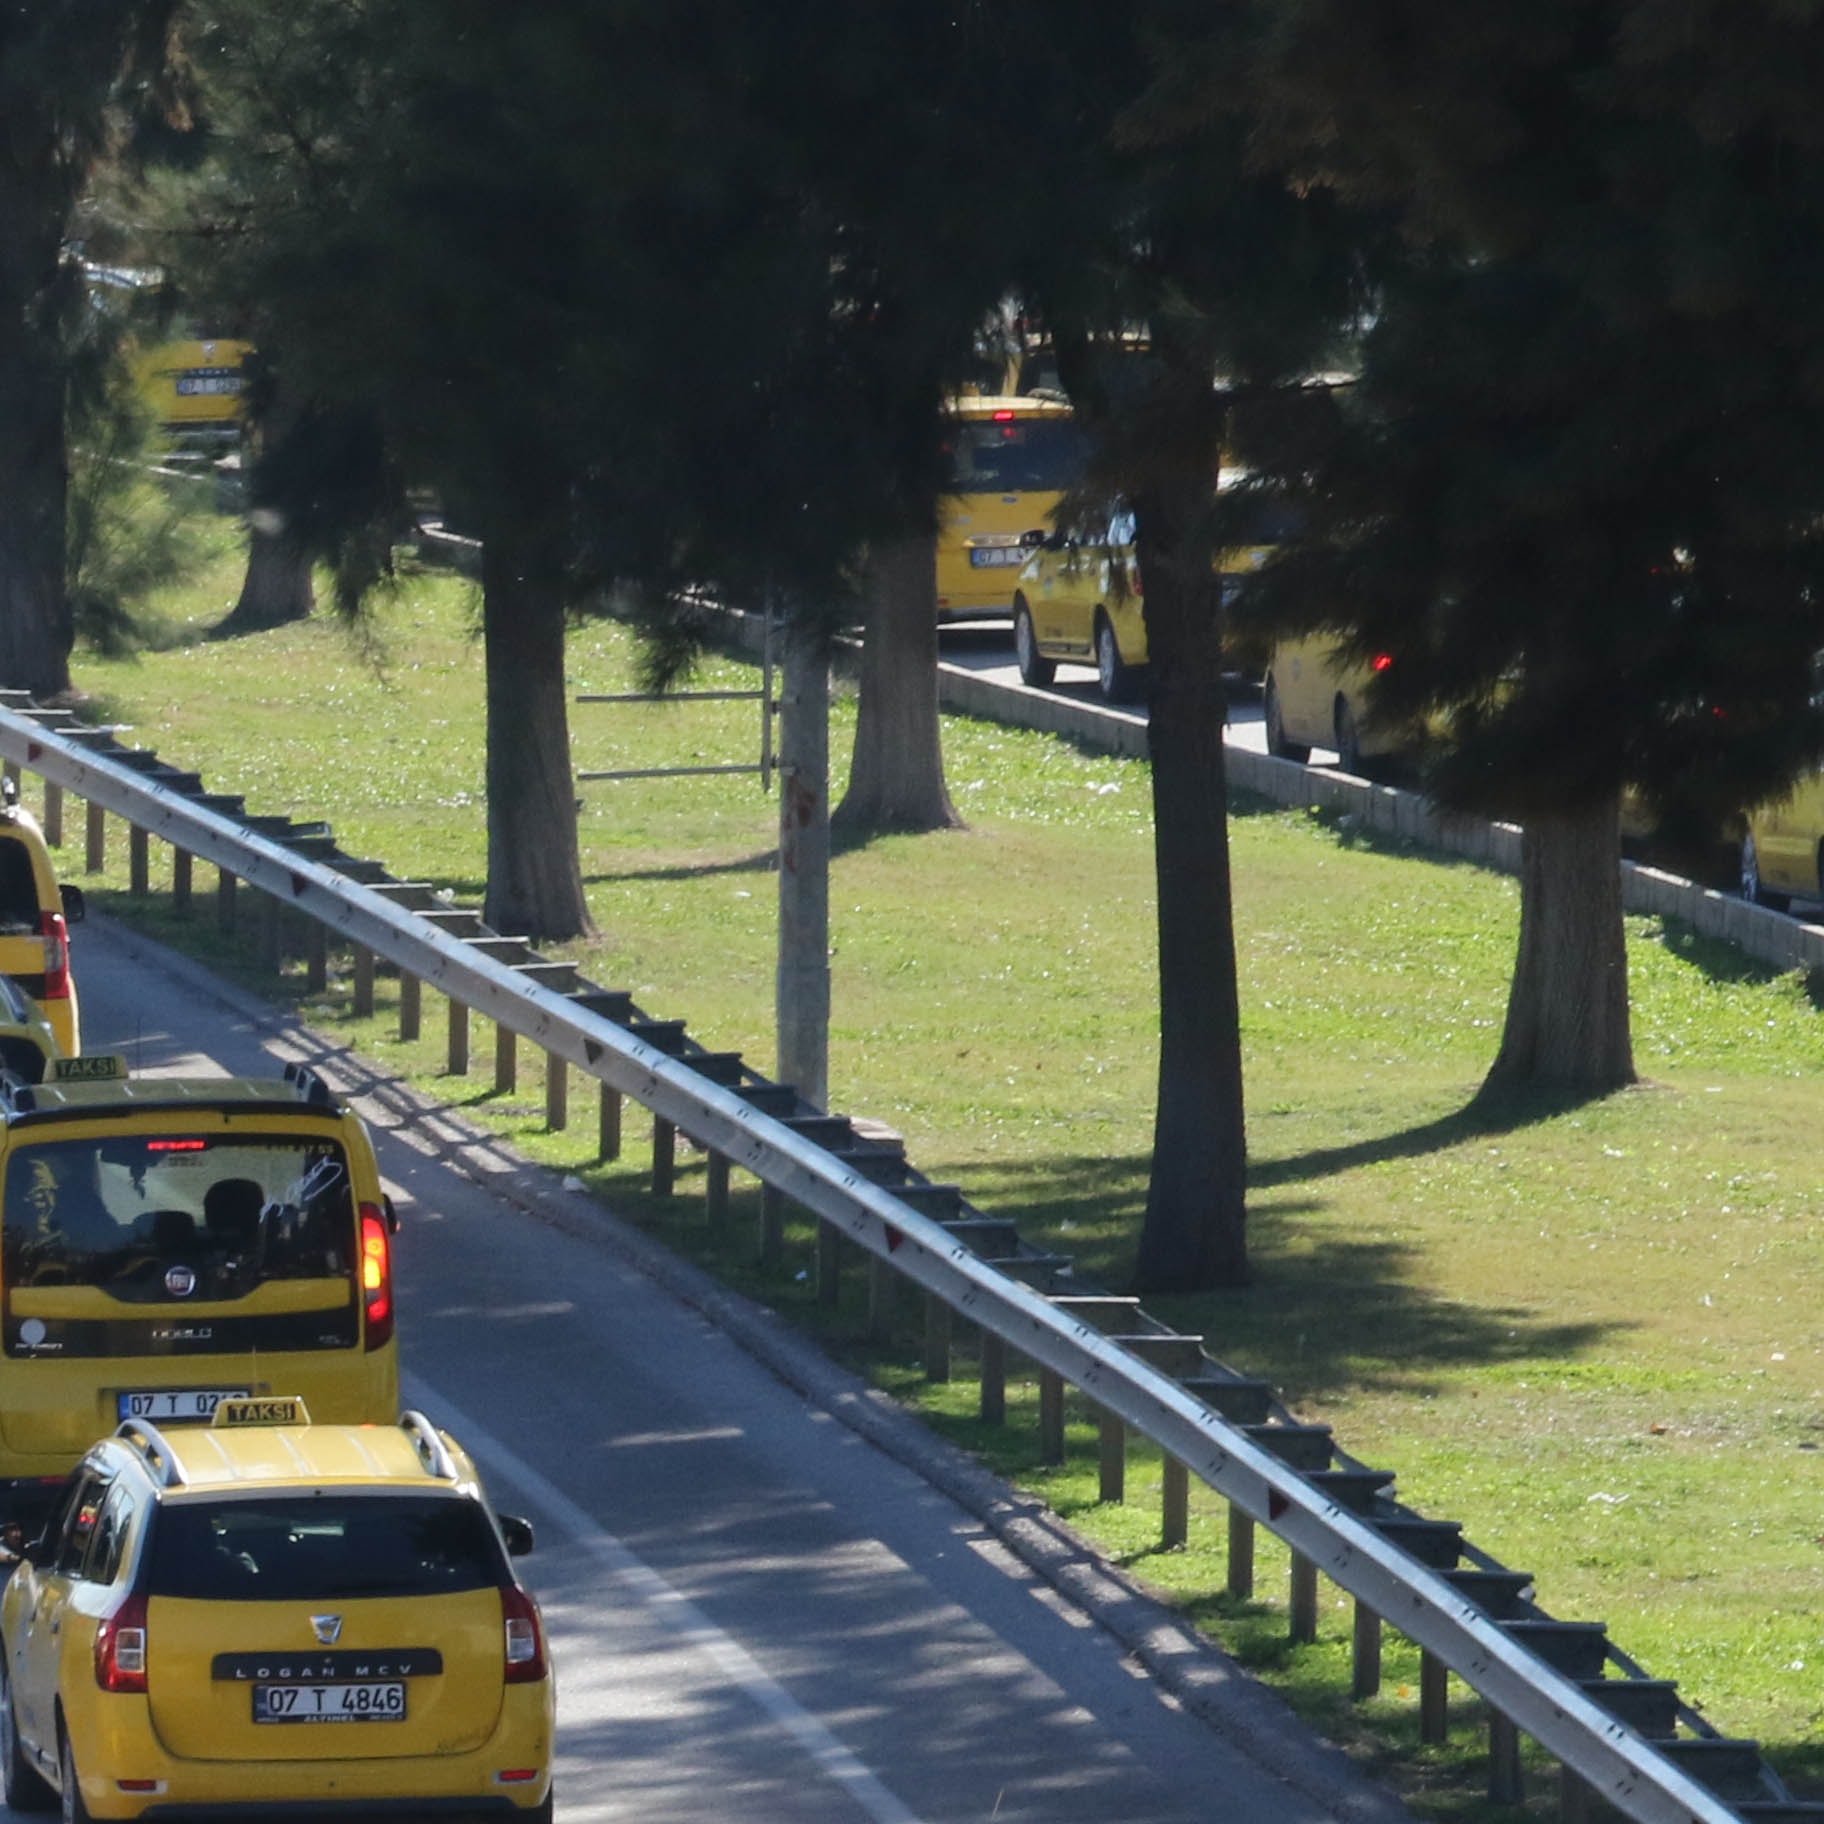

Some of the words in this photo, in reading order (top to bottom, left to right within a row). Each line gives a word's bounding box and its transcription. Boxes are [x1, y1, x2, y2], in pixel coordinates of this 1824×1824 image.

[131, 1395, 154, 1415] 07
[167, 1395, 179, 1413] T
[236, 1667, 334, 1678] LOGAN
[355, 1665, 412, 1677] MCV
[269, 1690, 298, 1713] 07
[312, 1690, 326, 1711] T
[342, 1687, 401, 1709] 4846
